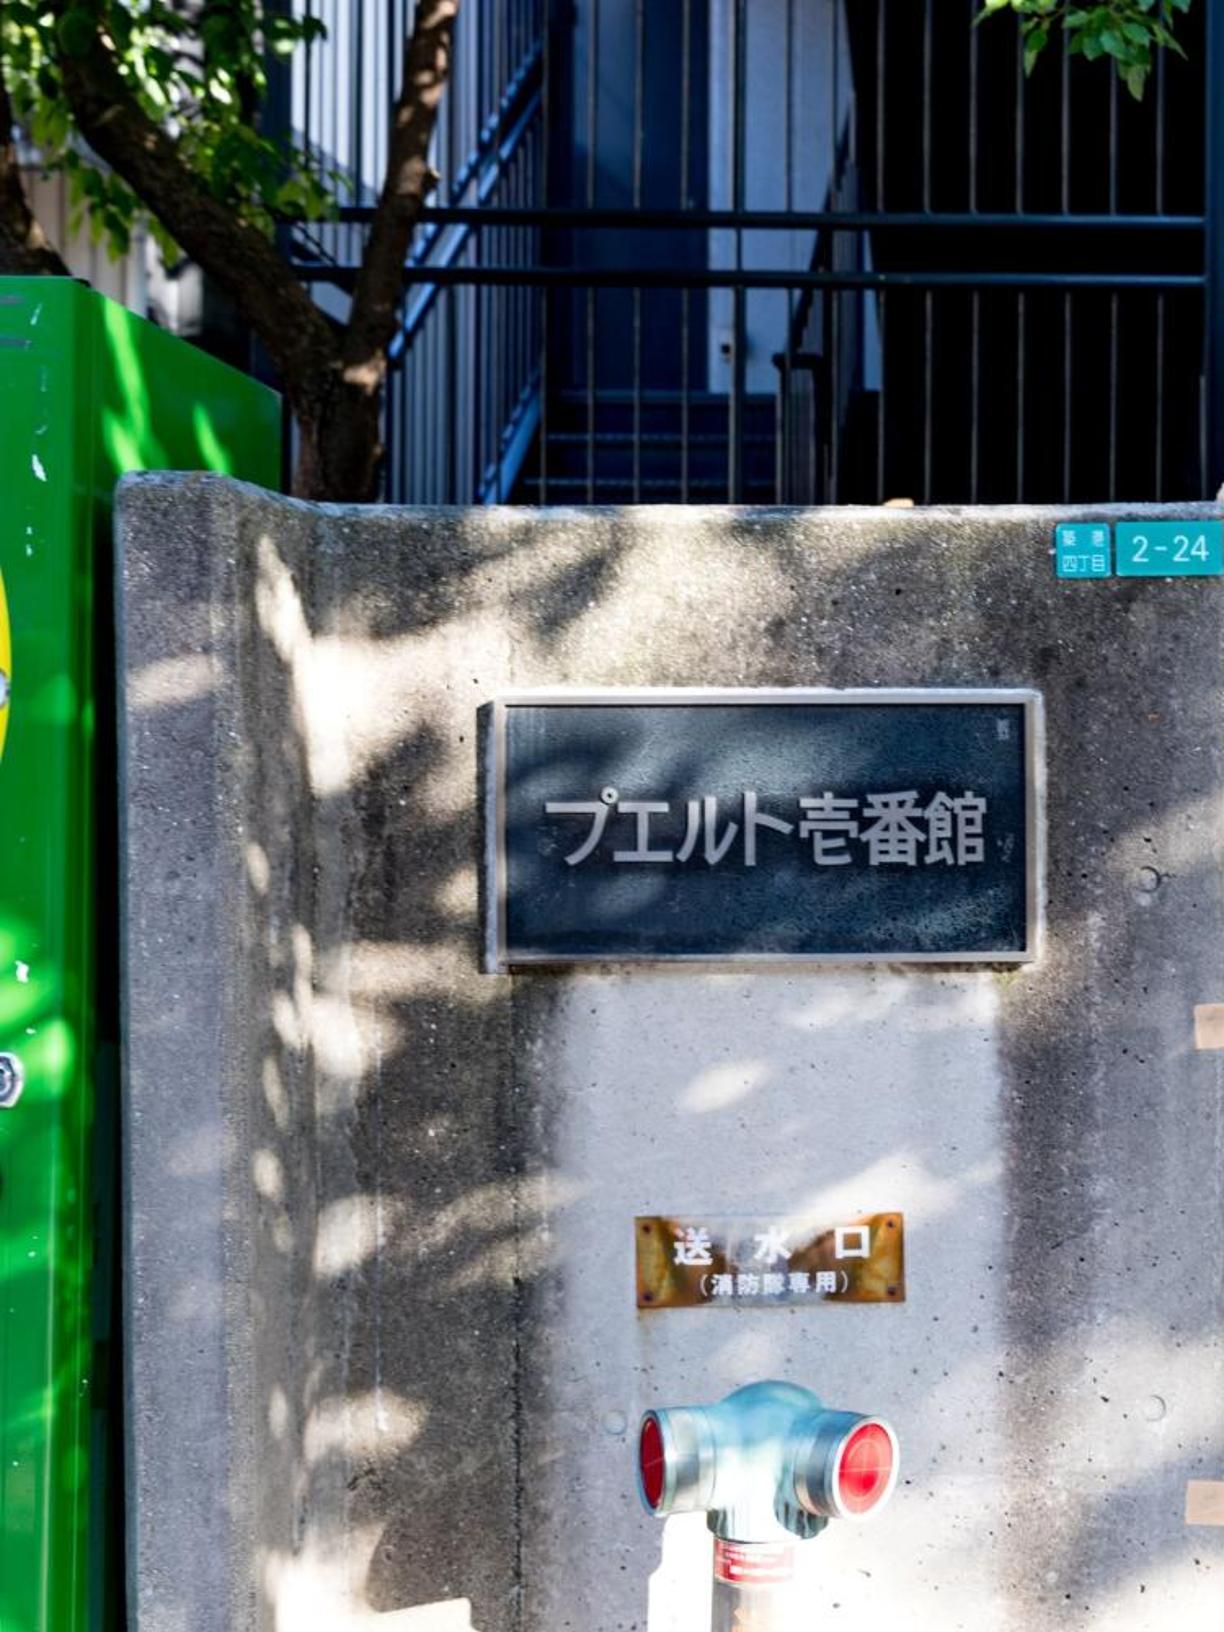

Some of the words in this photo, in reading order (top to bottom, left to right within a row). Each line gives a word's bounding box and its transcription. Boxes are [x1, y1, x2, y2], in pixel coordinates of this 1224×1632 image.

[1062, 555, 1105, 572] 四丁目
[1131, 535, 1209, 562] 2-24
[546, 786, 987, 866] プエルト壱番館
[674, 1225, 870, 1266] 送水口
